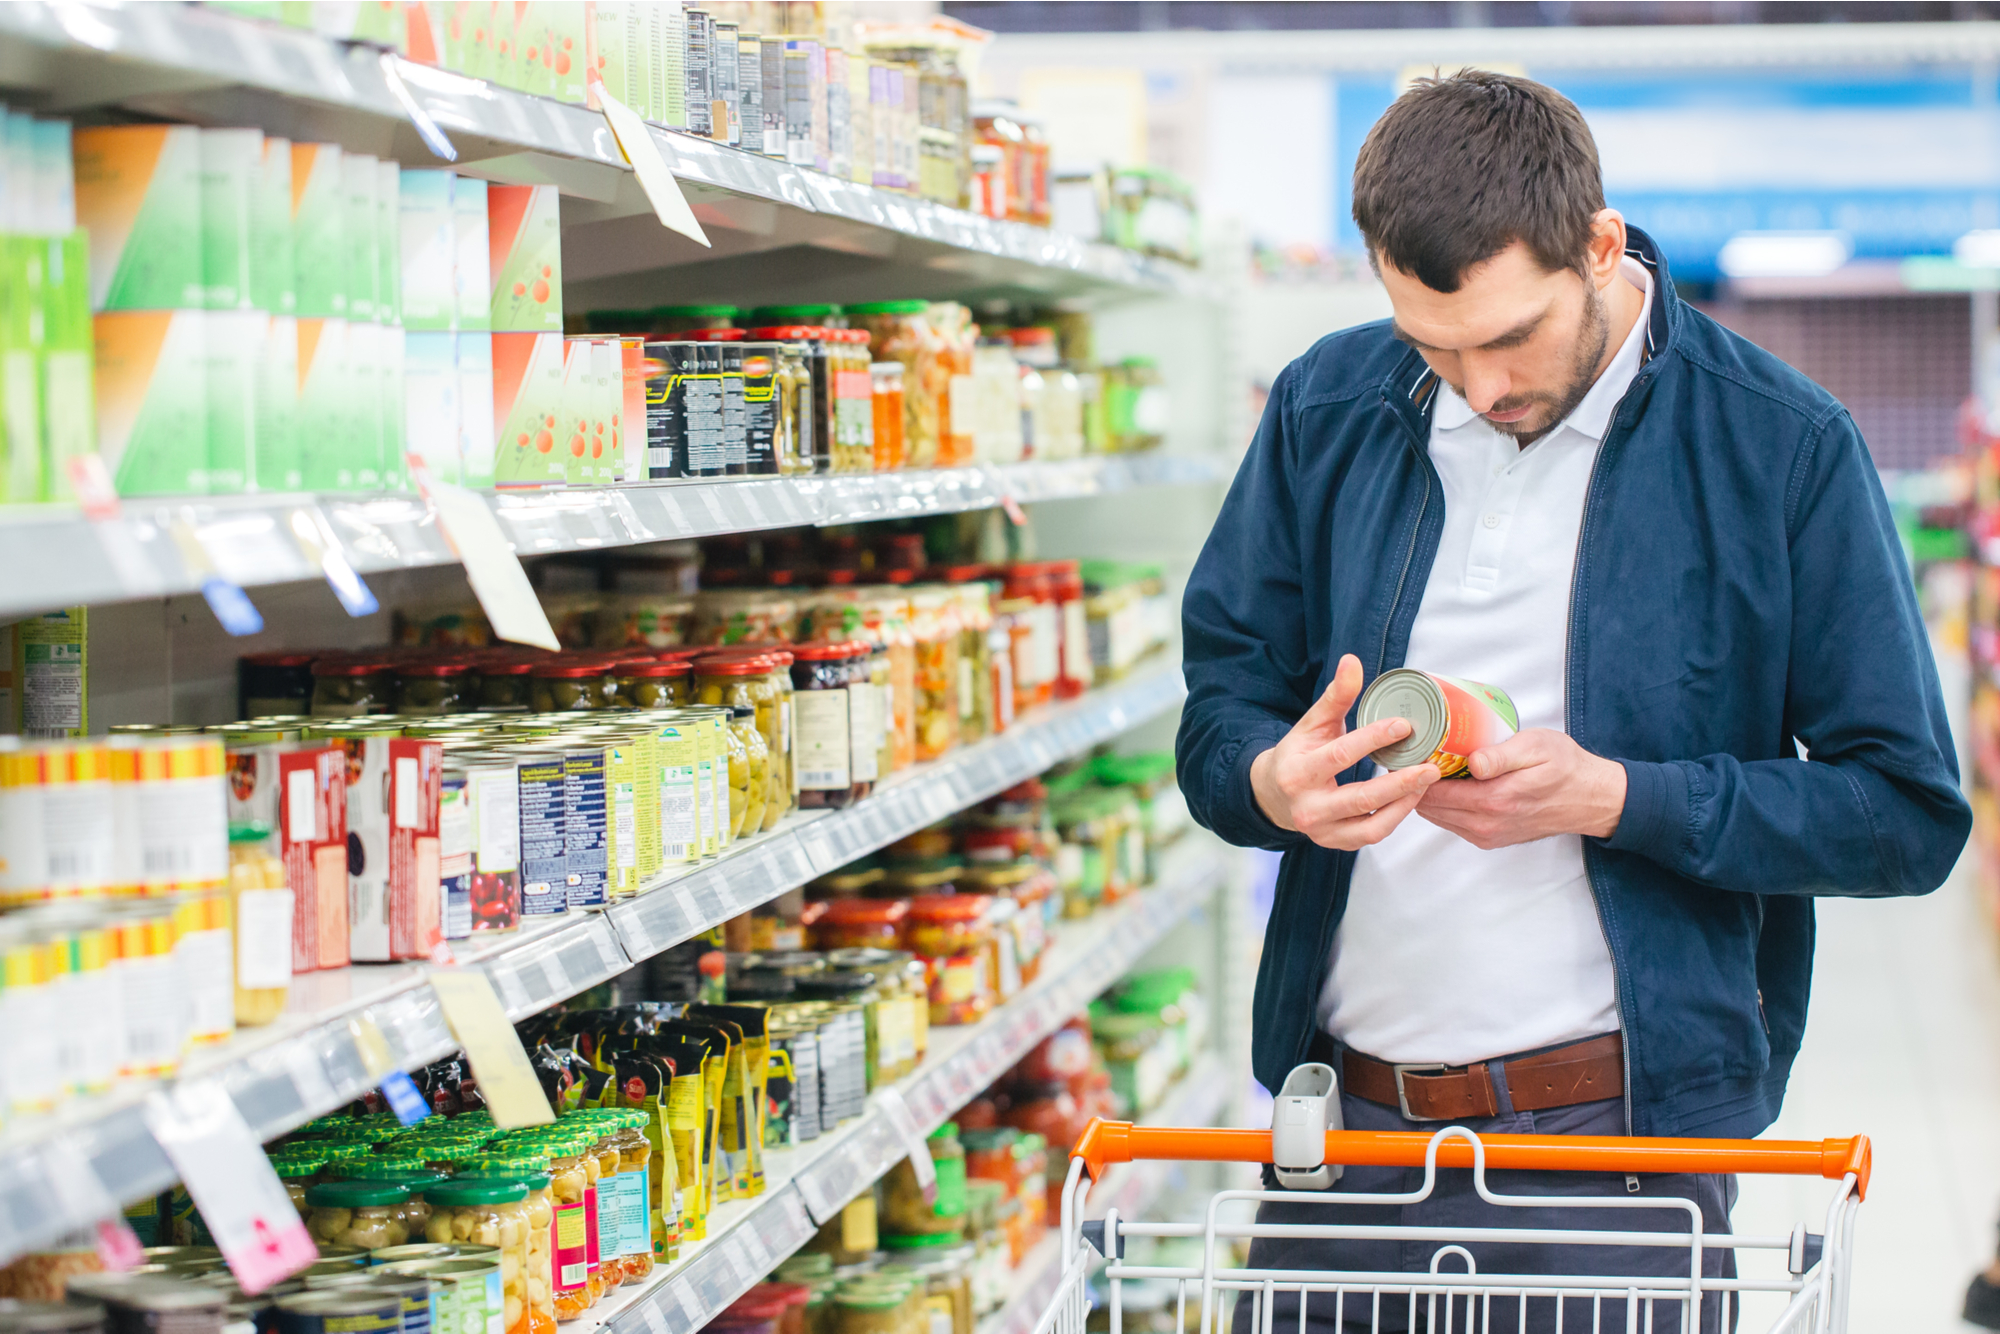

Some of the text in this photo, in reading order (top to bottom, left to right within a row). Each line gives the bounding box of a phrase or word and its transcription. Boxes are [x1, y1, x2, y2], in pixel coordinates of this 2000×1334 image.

[597, 12, 618, 22] NEW
[622, 367, 638, 377] ASIC
[1455, 713, 1464, 745] BASIC
